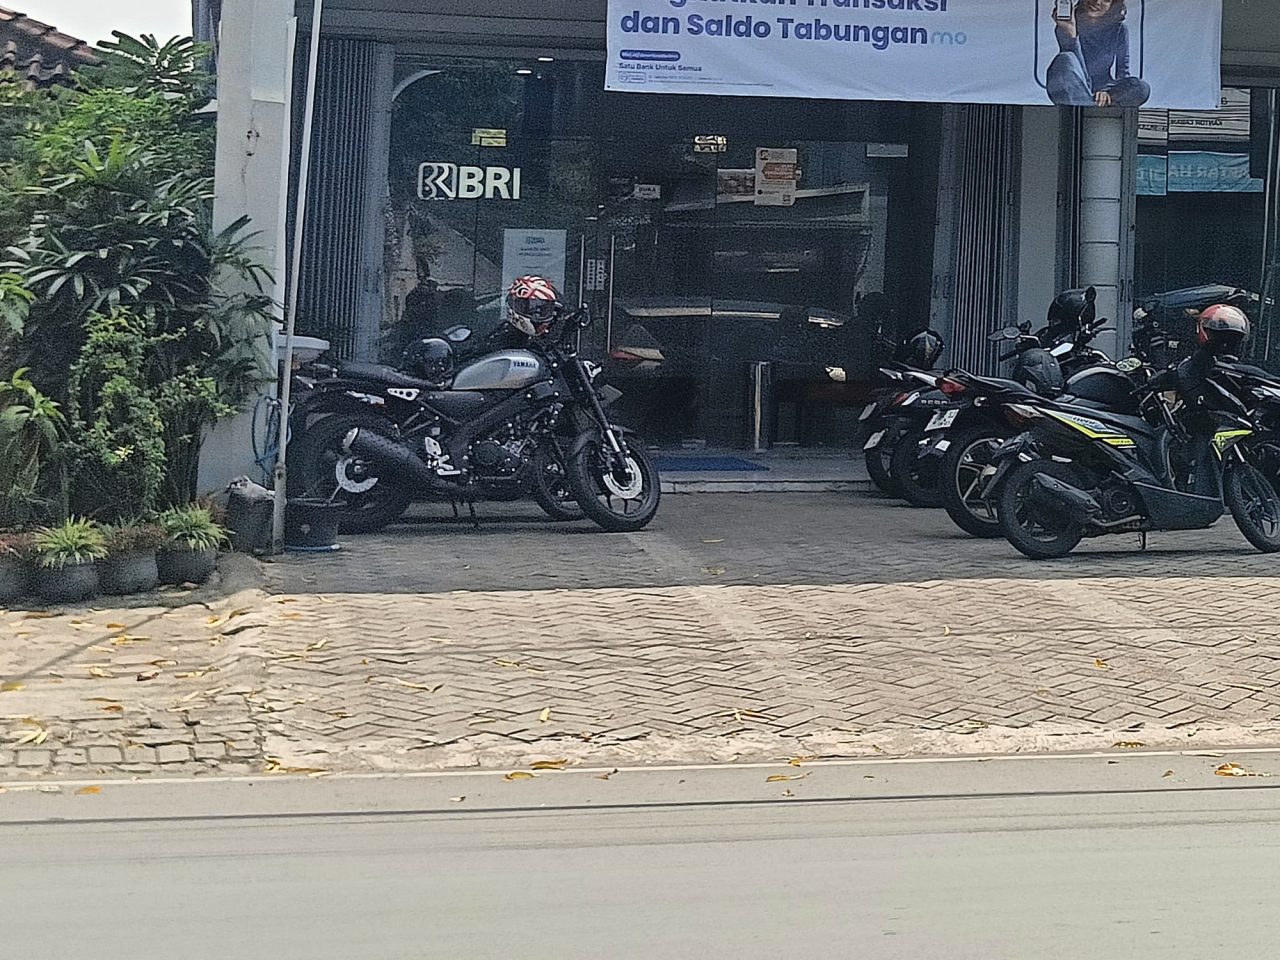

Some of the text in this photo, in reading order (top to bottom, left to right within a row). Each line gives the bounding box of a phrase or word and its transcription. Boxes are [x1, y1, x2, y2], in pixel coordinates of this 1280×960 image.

[620, 10, 680, 35] dan
[686, 14, 771, 39] Saldo
[776, 17, 928, 51] Tabungan
[618, 62, 635, 70] Satu
[636, 63, 654, 71] Bank
[458, 165, 521, 200] BRI
